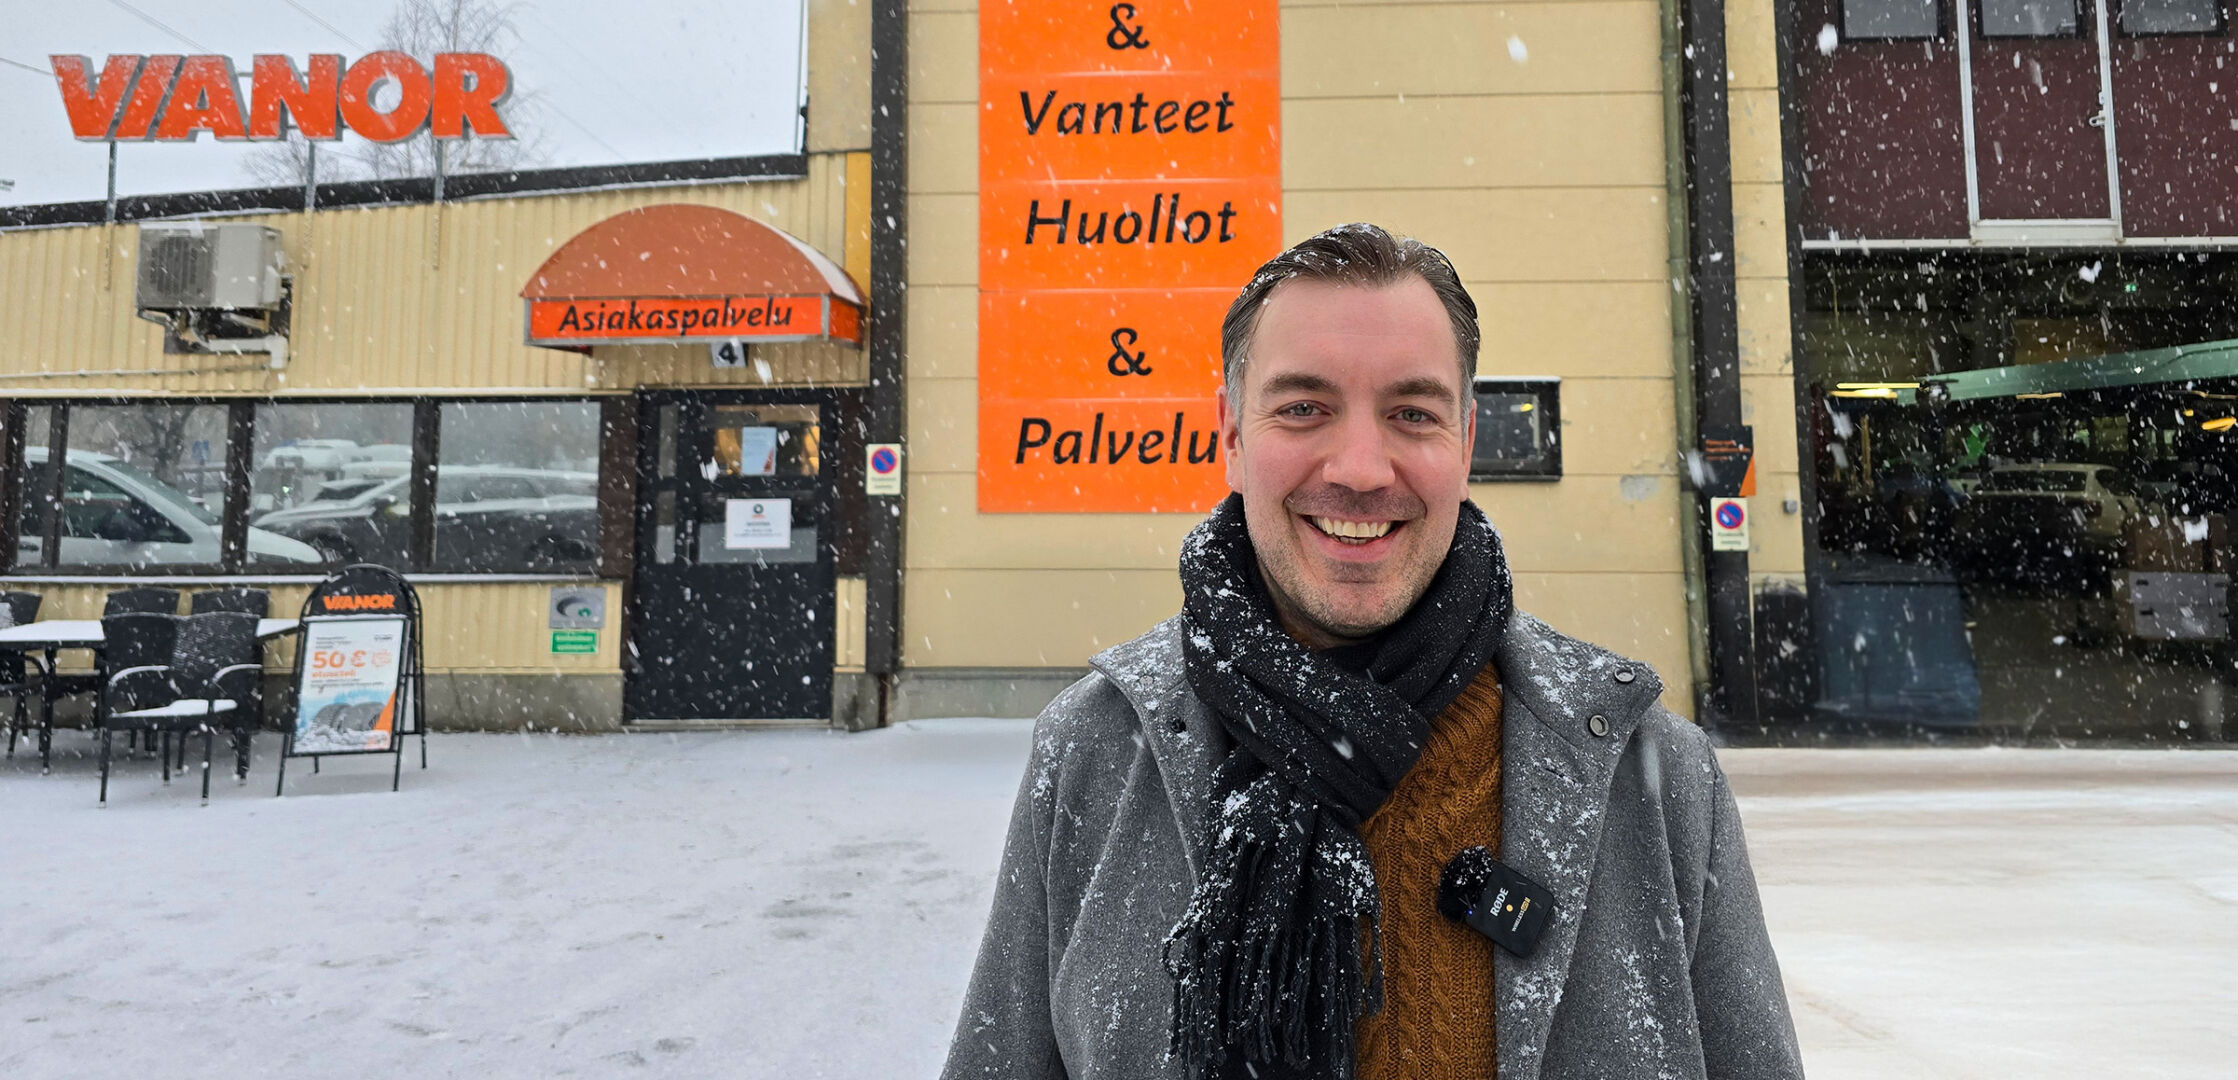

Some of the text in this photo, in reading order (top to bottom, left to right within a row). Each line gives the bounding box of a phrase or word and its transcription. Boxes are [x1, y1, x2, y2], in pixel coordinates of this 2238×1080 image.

[1106, 3, 1150, 50] &
[49, 50, 515, 142] VIANOR
[1019, 90, 1235, 135] Vanteet
[1025, 193, 1237, 244] Huollot
[558, 297, 793, 336] Asiakaspalvelu
[718, 342, 738, 364] 4
[1107, 327, 1152, 376] &
[1015, 412, 1219, 464] Palvelu
[323, 594, 395, 610] VIANOR
[312, 650, 346, 669] 50
[1490, 888, 1509, 917] RØDE
